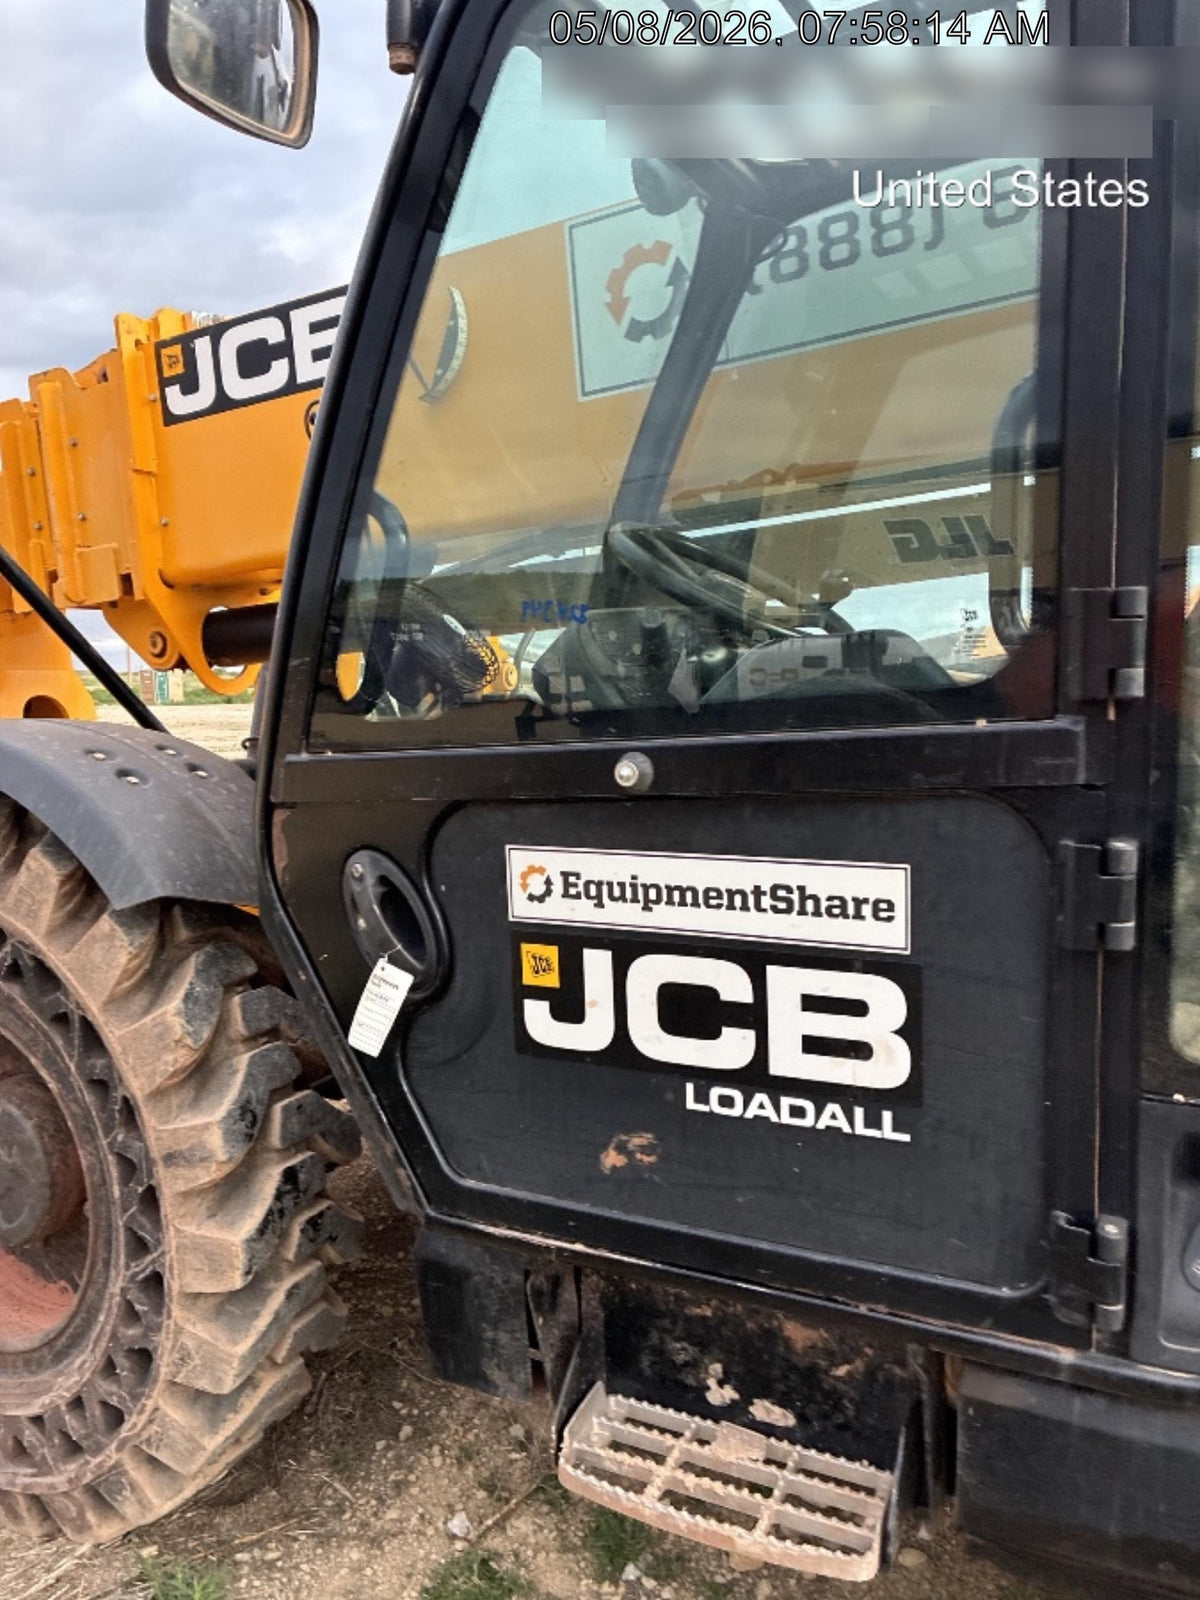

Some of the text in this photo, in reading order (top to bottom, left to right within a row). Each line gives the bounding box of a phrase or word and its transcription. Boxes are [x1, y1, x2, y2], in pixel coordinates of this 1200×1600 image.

[747, 183, 945, 295] 888)
[560, 870, 896, 923] EquipmentShare
[523, 947, 912, 1090] JCB
[685, 1082, 911, 1142] LOADALL
